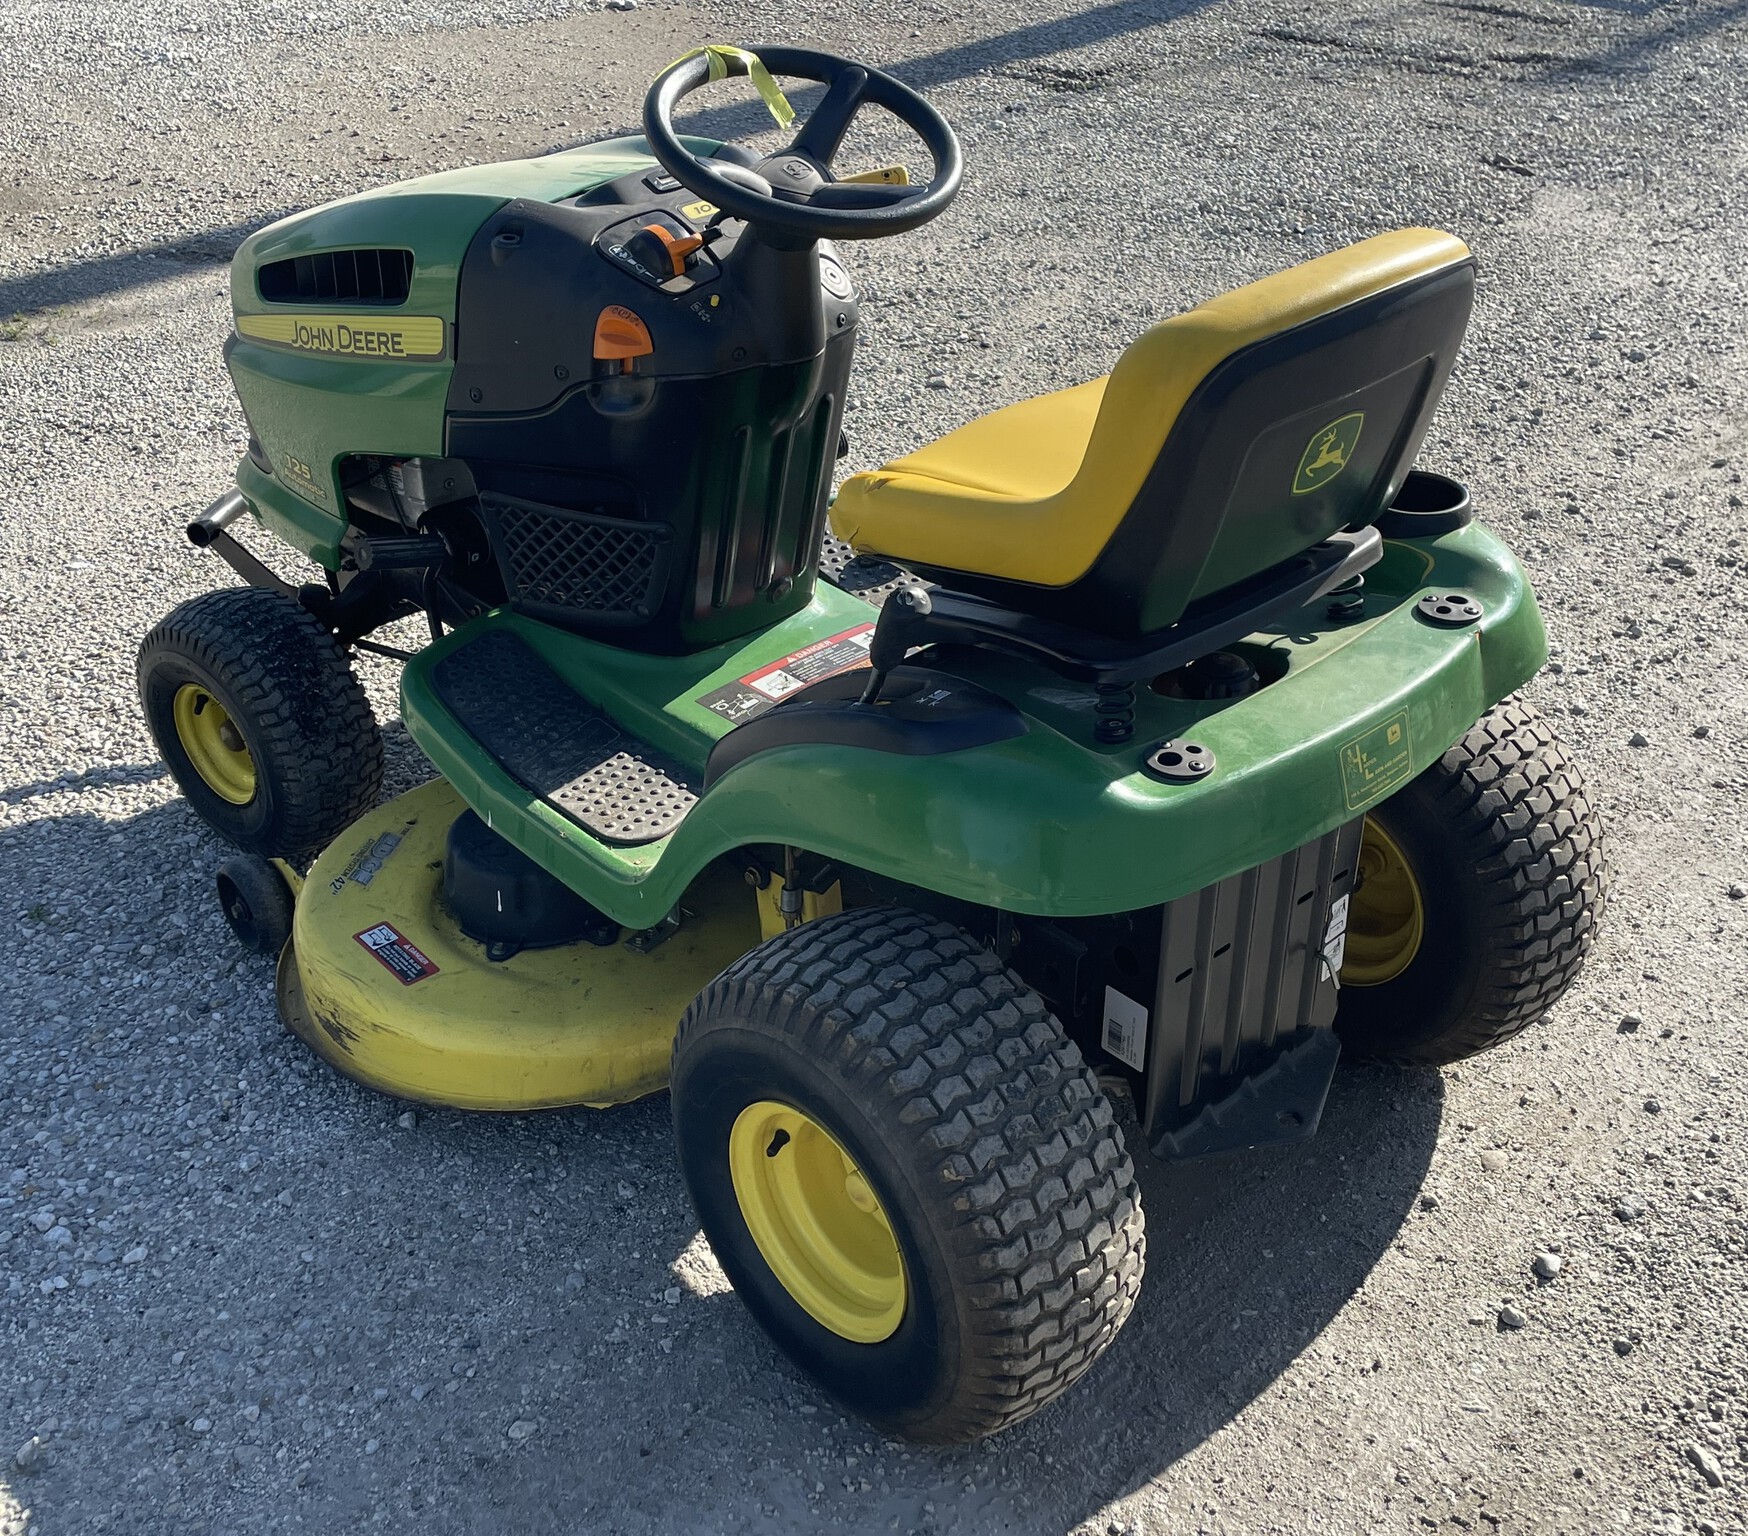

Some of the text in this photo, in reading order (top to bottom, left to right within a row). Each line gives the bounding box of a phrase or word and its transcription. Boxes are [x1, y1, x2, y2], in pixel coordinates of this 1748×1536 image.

[291, 321, 404, 354] JOHN DEERE
[284, 453, 311, 479] 125
[795, 640, 833, 658] DANGER
[350, 831, 402, 886] EDGE
[408, 947, 429, 965] DANGER
